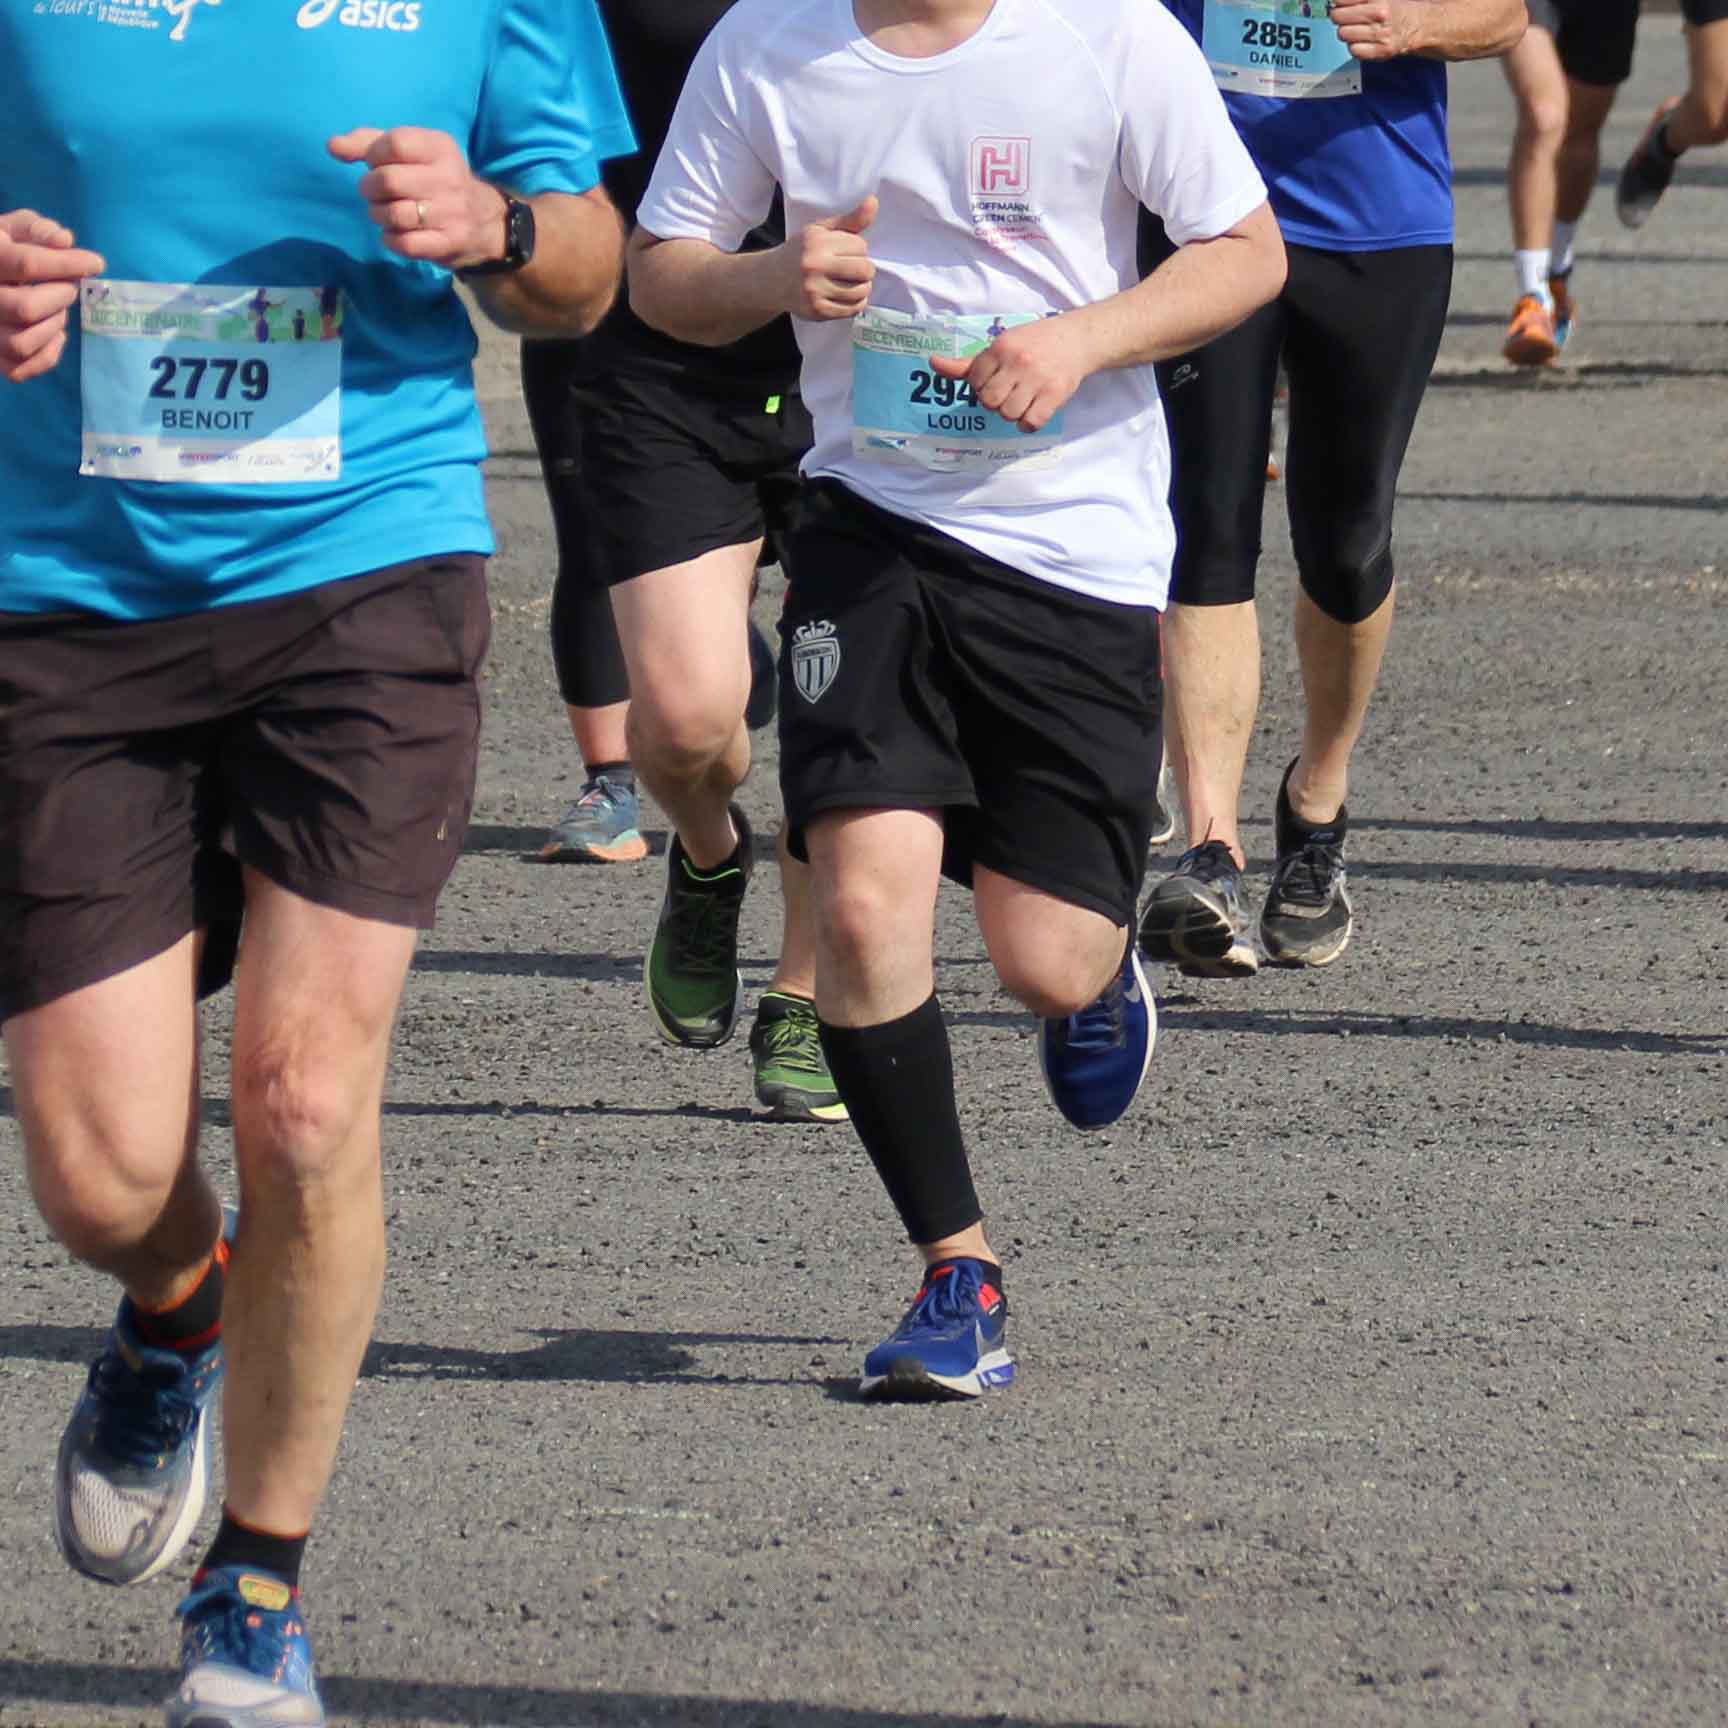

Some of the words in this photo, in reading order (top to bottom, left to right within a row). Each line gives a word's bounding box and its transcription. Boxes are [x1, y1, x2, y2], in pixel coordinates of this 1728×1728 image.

[1241, 18, 1312, 52] 2855
[1249, 51, 1304, 69] DANIEL
[148, 355, 269, 402] 2779
[909, 369, 978, 409] 294
[161, 407, 254, 432] BENOIT
[927, 412, 987, 433] LOUIS
